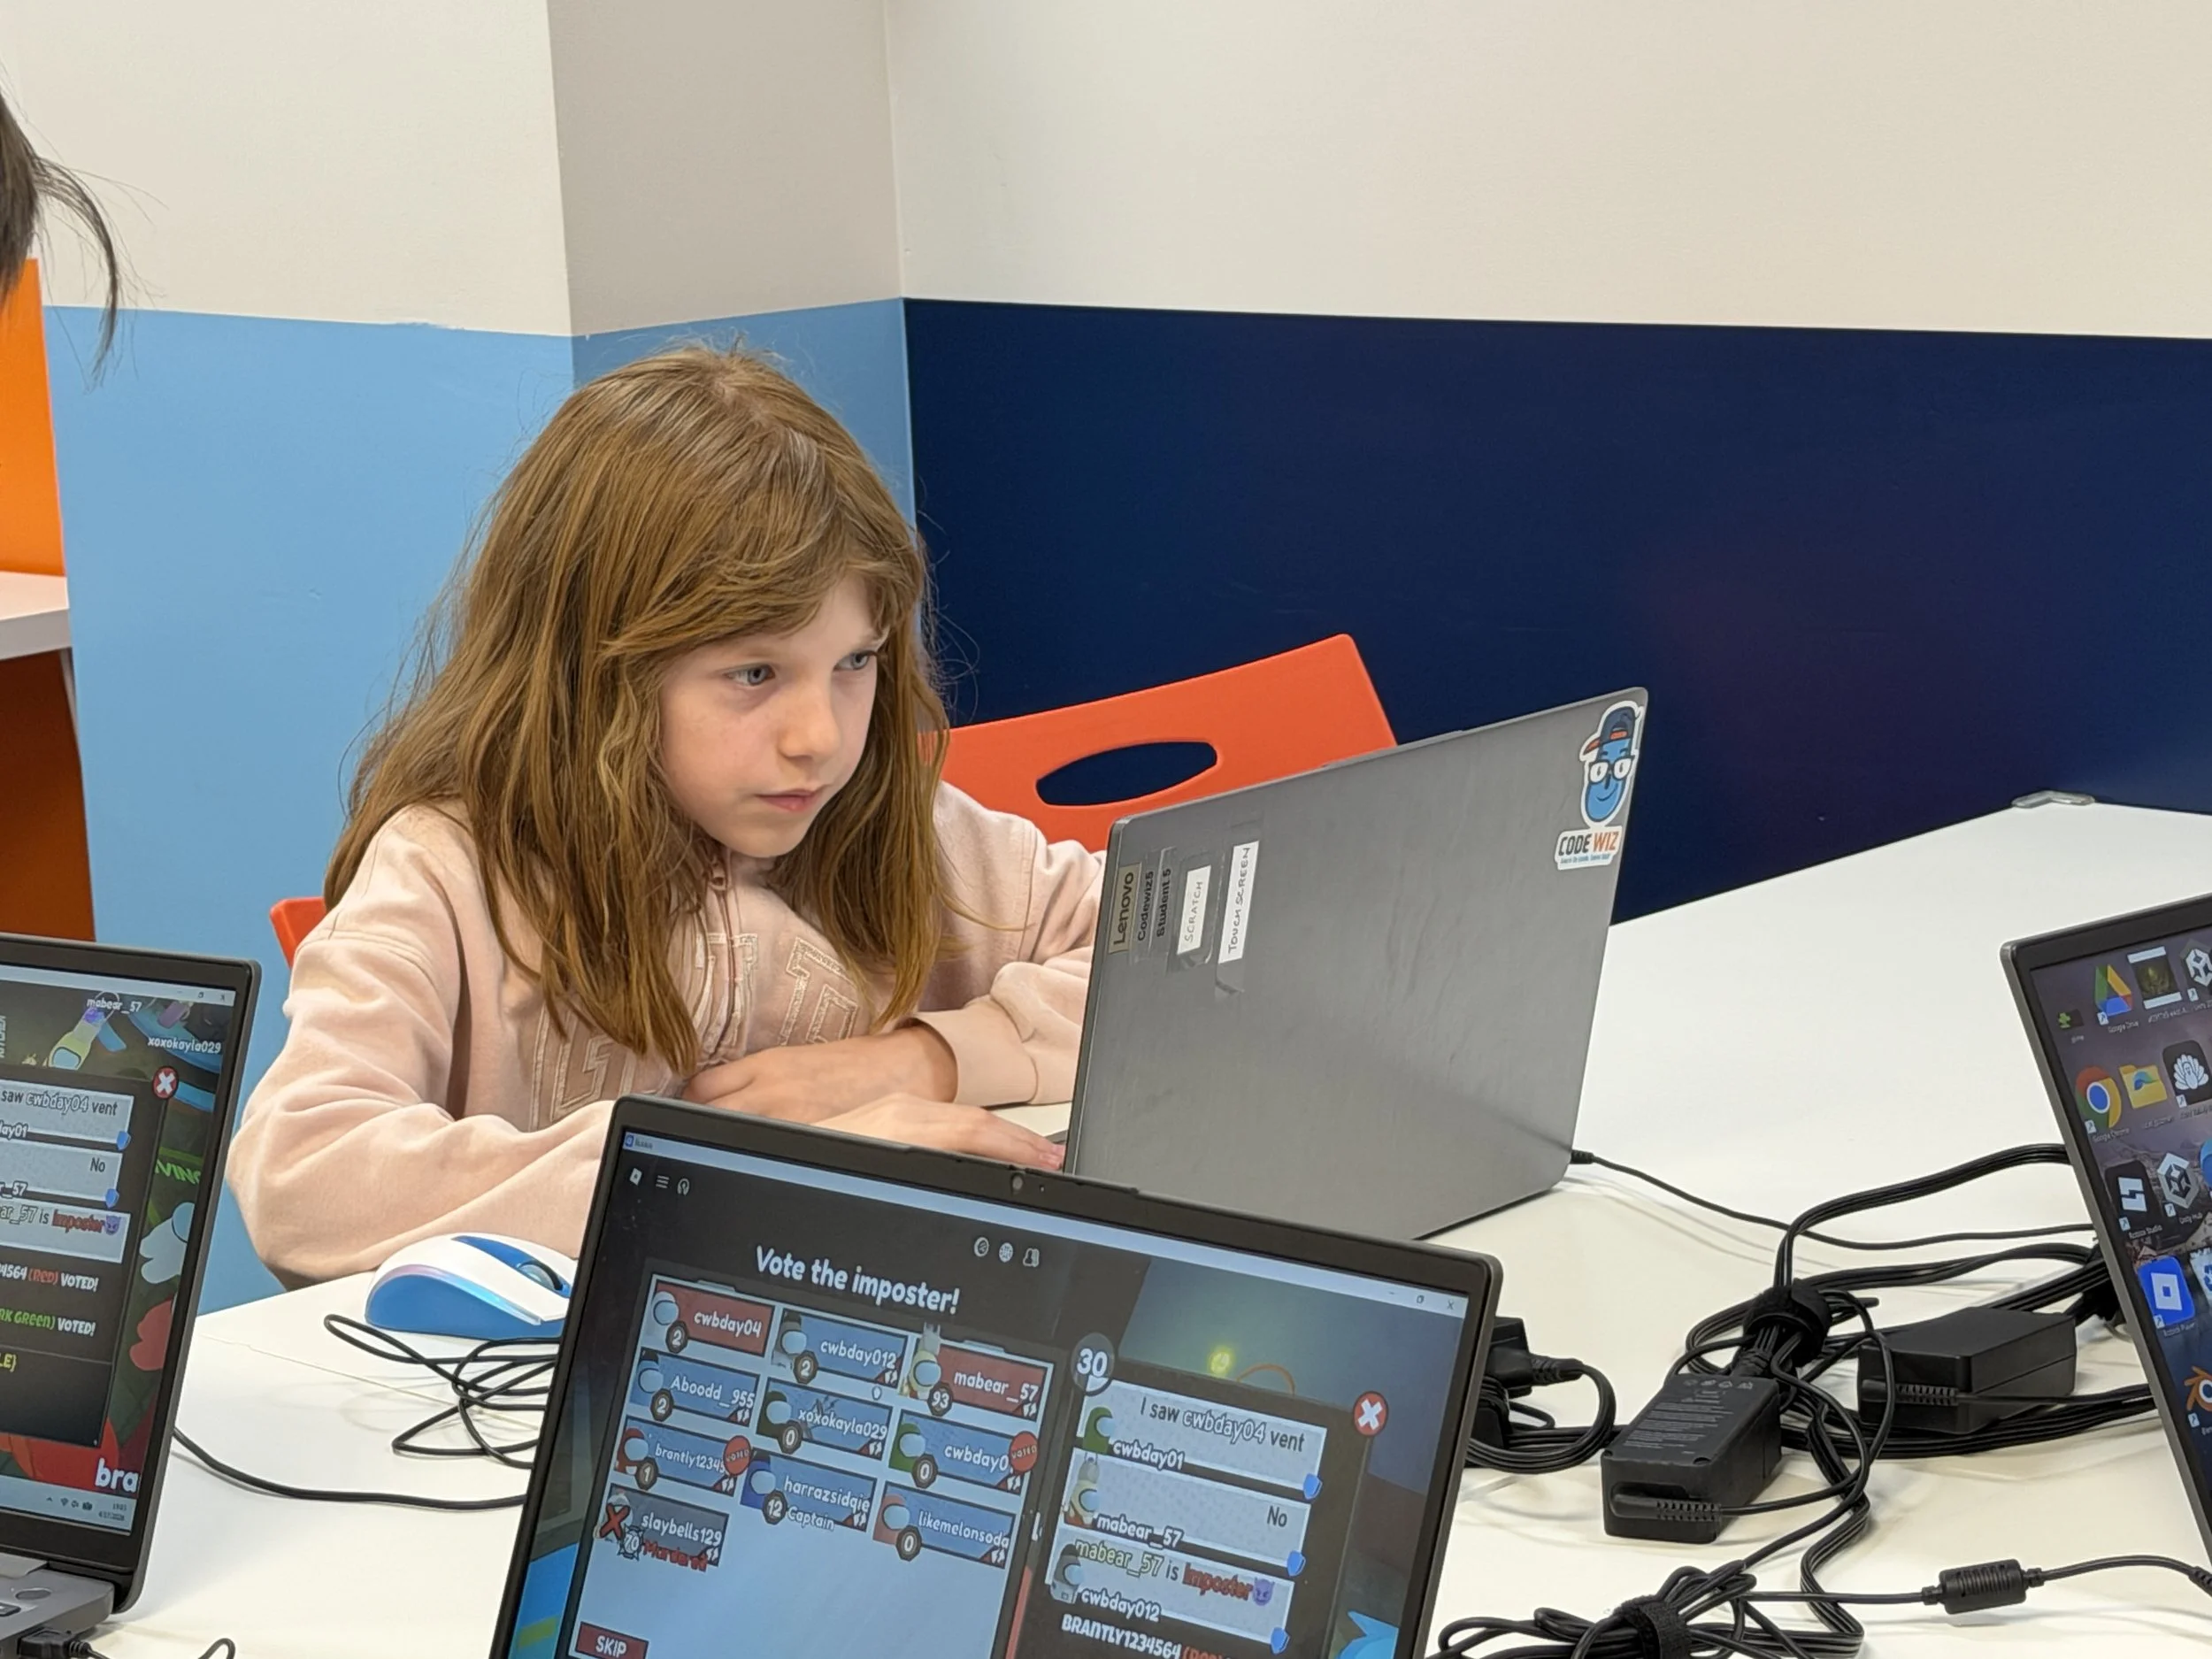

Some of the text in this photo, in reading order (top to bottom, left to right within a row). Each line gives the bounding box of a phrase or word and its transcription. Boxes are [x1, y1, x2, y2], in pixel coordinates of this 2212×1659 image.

[1558, 831, 1619, 856] CODE WIZ
[1113, 872, 1134, 945] Lenovo
[1156, 868, 1171, 938] Student 5
[1185, 881, 1203, 943] SCRATCH
[1227, 847, 1251, 954] TOUCH SCREEN
[87, 997, 142, 1015] mabear_57
[147, 1036, 221, 1054] xoxokayla029
[2, 1090, 118, 1116] saw cwbday04 vent
[90, 1157, 106, 1172] No
[39, 1209, 50, 1224] is
[61, 1272, 99, 1292] VOTED!
[757, 1245, 961, 1315] Vote the imposter!
[58, 1317, 96, 1337] VOTED!
[694, 1310, 762, 1338] cwbday04
[672, 1330, 682, 1347] 2
[820, 1340, 897, 1369] cwbday012
[1077, 1348, 1108, 1377] 30
[801, 1361, 812, 1377] 2
[670, 1375, 755, 1407] Aboodd_955
[932, 1391, 949, 1409] 93
[954, 1371, 1039, 1403] mabear_57
[657, 1397, 667, 1414] 2
[786, 1429, 795, 1446] 0
[798, 1409, 887, 1440] xoxokayla029
[1141, 1396, 1305, 1452] I saw cwbday04 vent
[944, 1445, 1014, 1473] cwbday0
[1112, 1440, 1186, 1470] cwbday01
[95, 1457, 139, 1494] bra
[643, 1466, 650, 1482] 1
[919, 1463, 929, 1479] 0
[768, 1498, 782, 1517] 12
[787, 1506, 834, 1532] Captain
[1267, 1506, 1287, 1527] No
[641, 1512, 722, 1547] slaybells129
[918, 1510, 1010, 1548] likemelonsoda
[1096, 1511, 1184, 1548] mabear_57
[904, 1535, 914, 1552] 0
[1075, 1540, 1164, 1578] mabear_57
[1165, 1560, 1179, 1581] is
[1081, 1589, 1162, 1623] cwbday012
[595, 1635, 627, 1658] SKIP
